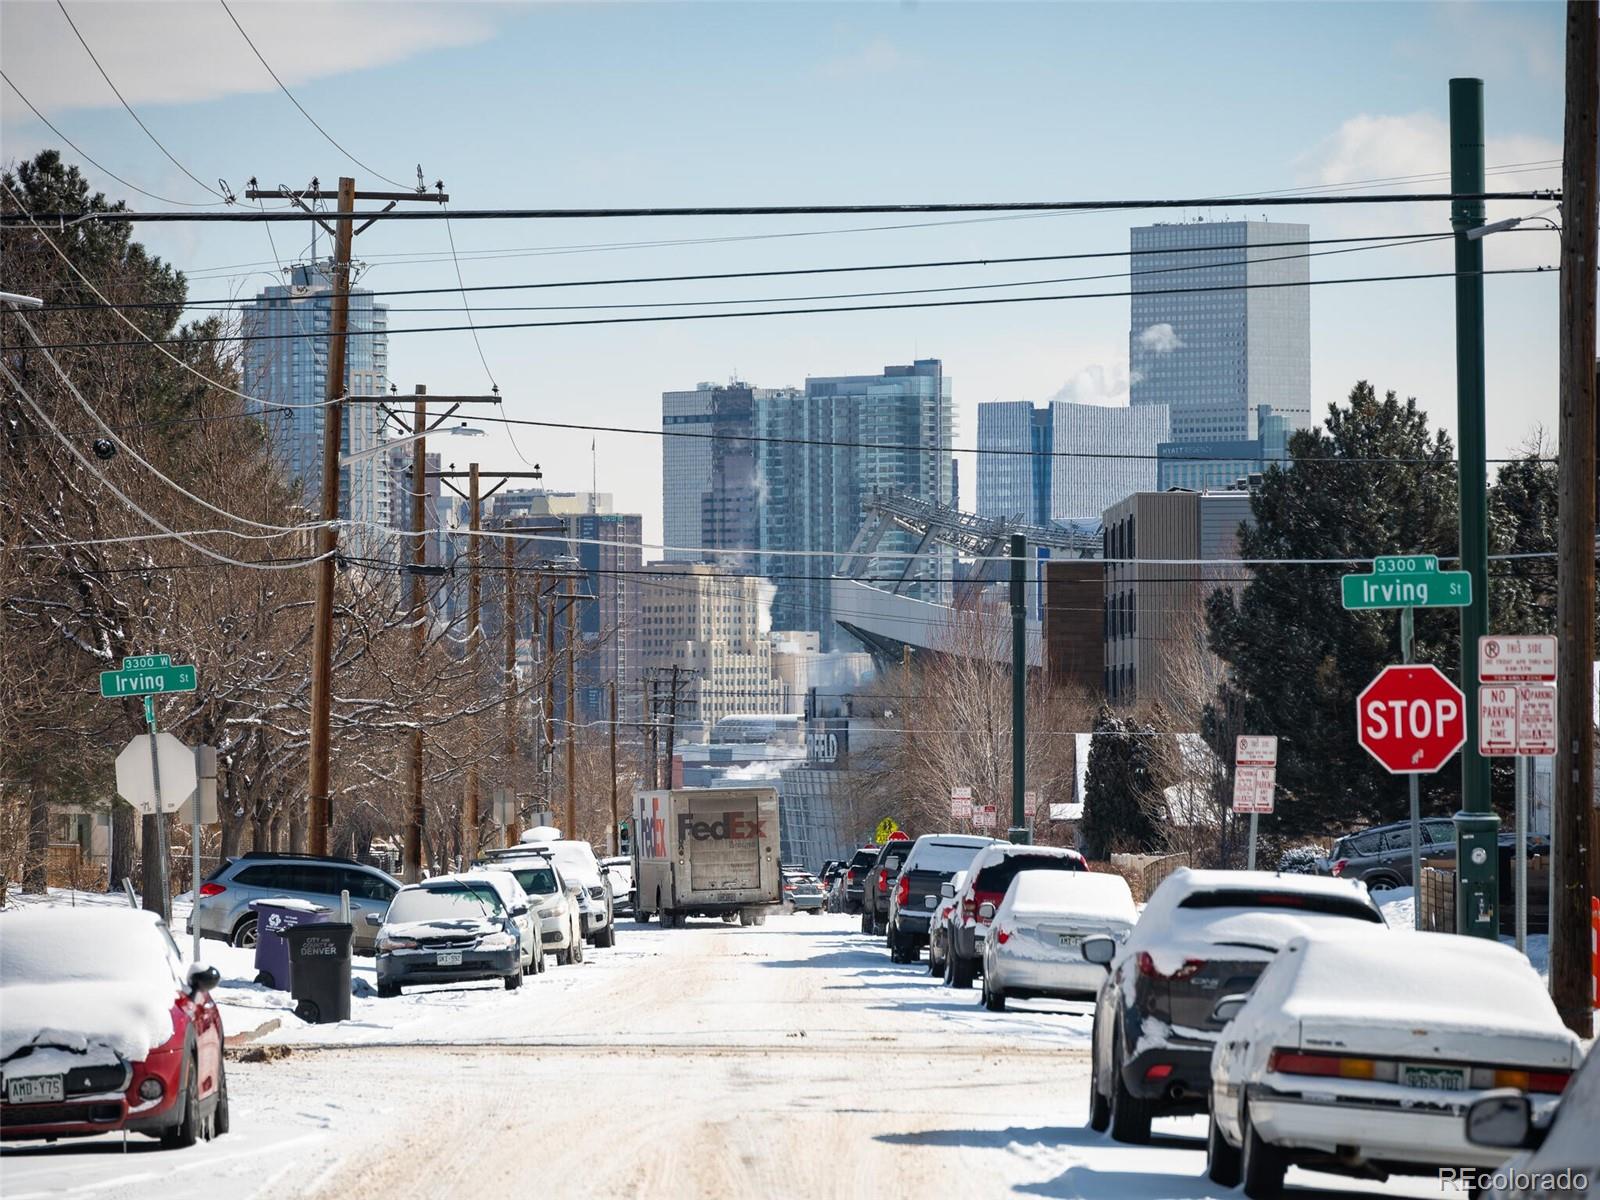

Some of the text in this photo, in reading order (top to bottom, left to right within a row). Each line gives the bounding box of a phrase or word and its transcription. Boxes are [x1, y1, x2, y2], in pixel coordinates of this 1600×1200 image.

[1378, 559, 1435, 572] 3300 W
[1363, 580, 1462, 604] Irving St
[125, 656, 169, 669] 3300 W
[115, 673, 189, 692] Irving St
[1491, 689, 1505, 703] NO
[1520, 689, 1530, 702] NO
[1482, 706, 1515, 719] PARKING
[1366, 699, 1458, 740] STOP
[1491, 720, 1505, 728] ANY
[1490, 730, 1505, 738] TIME
[677, 811, 768, 842] FedEx
[300, 947, 337, 956] DENVER
